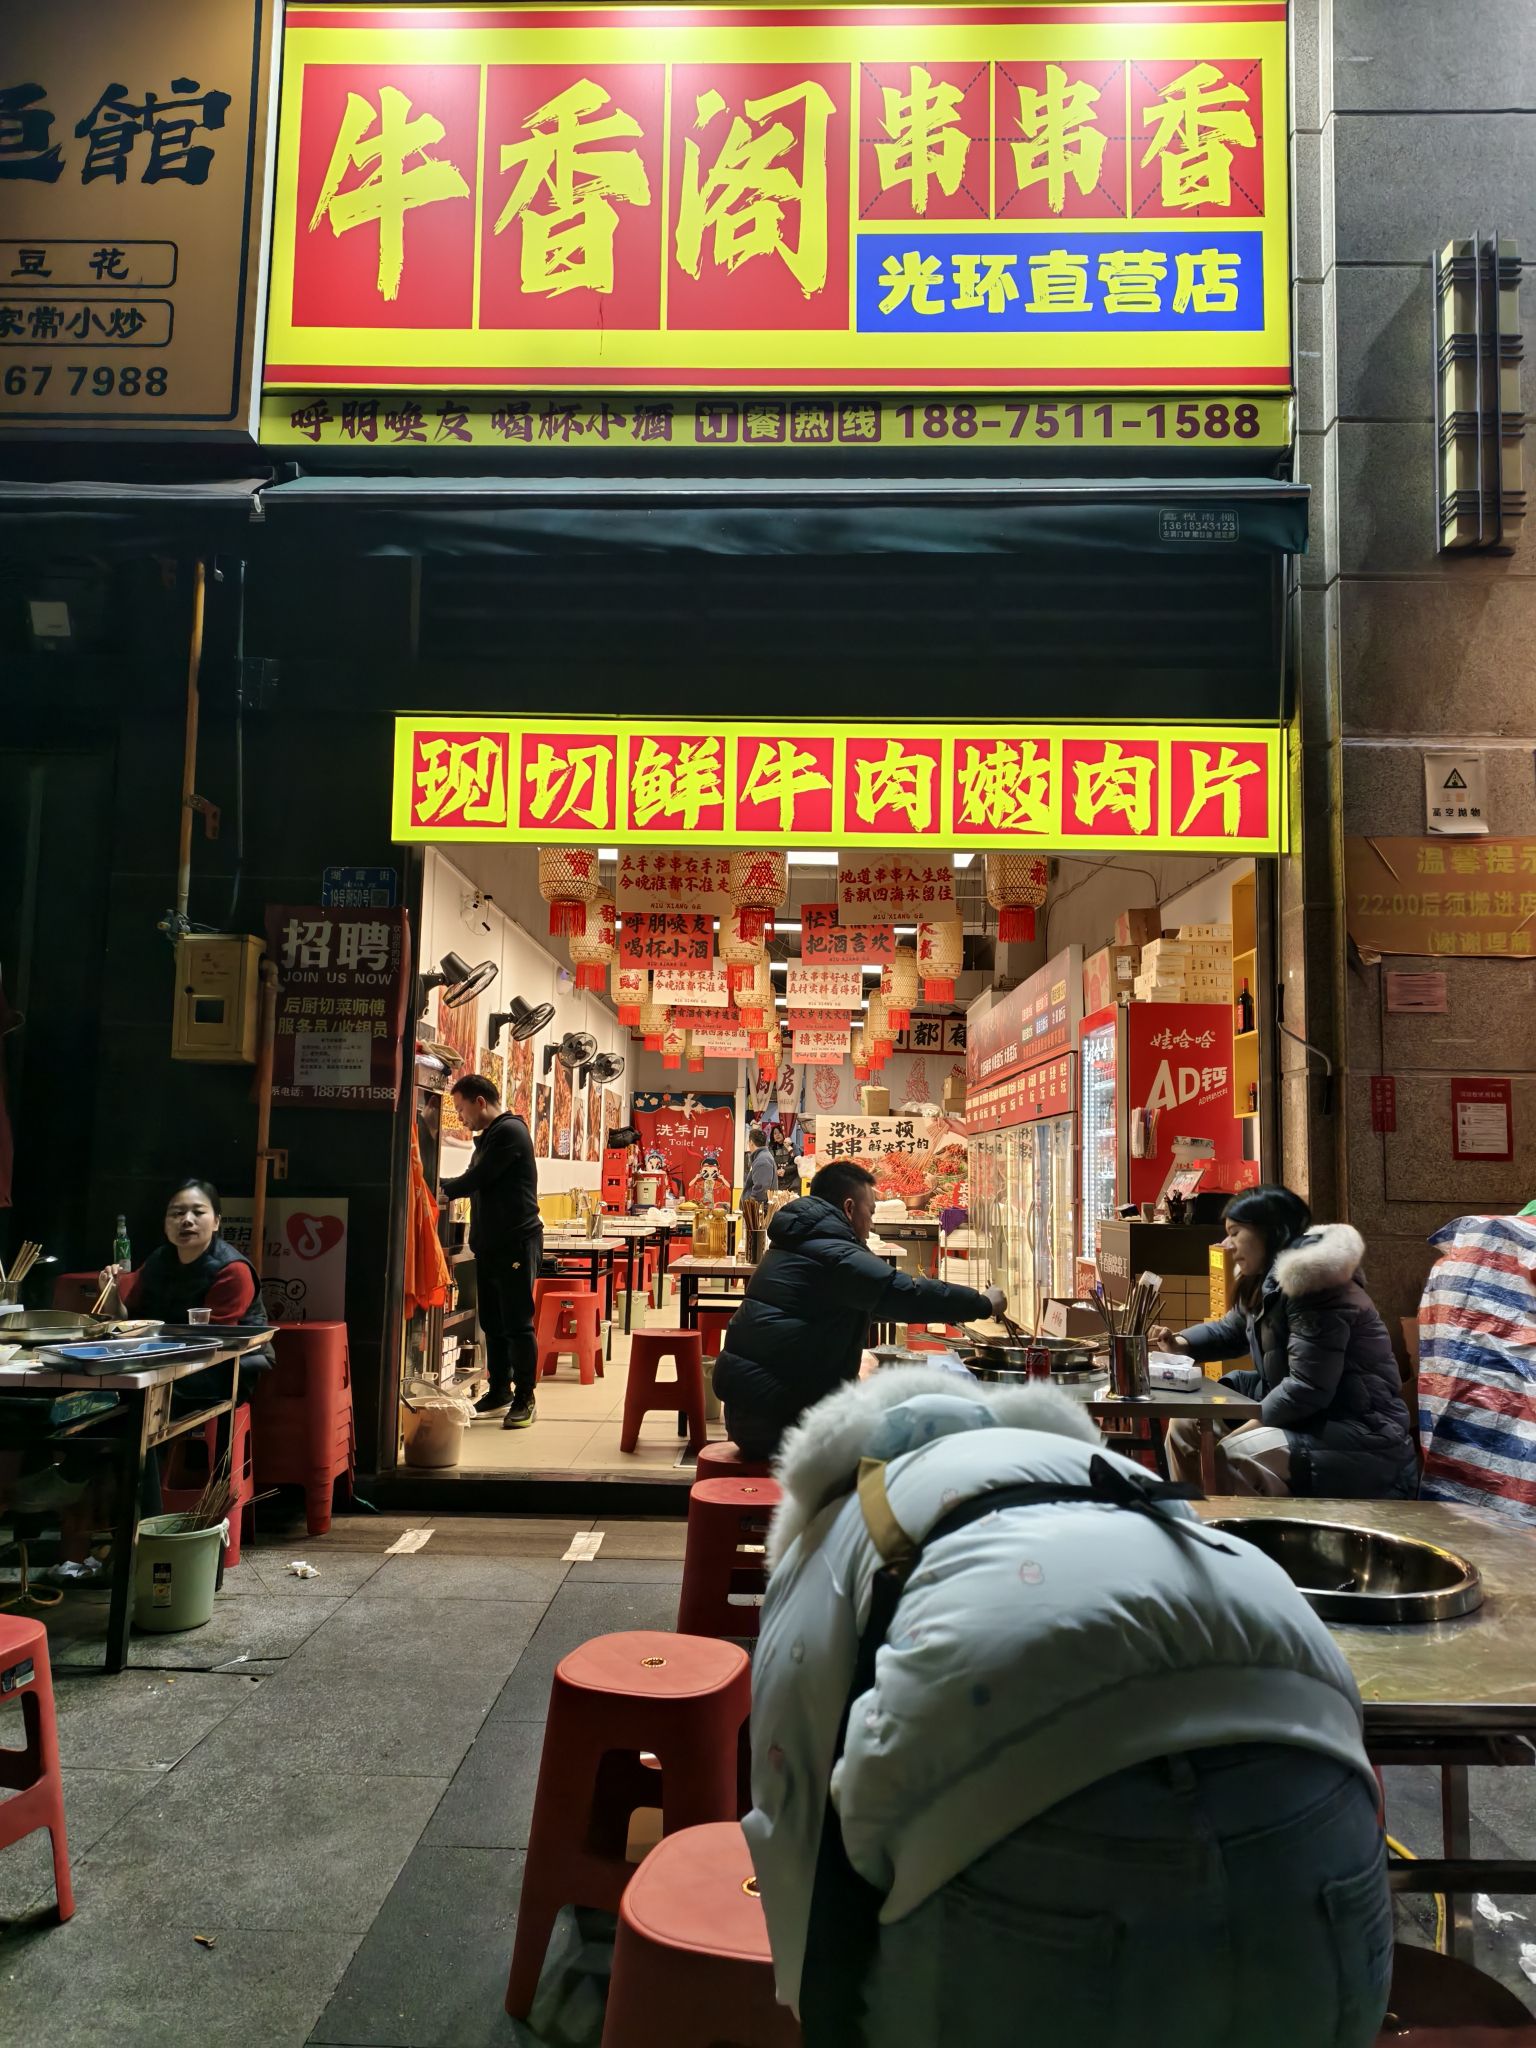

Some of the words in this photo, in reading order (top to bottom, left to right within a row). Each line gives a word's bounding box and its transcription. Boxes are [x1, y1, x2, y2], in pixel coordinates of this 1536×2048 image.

[309, 77, 837, 302] 牛香阁
[873, 61, 1258, 214] 串串香
[10, 247, 130, 281] 豆花
[877, 248, 1242, 316] 光环直营店
[0, 306, 148, 339] 家常小炒
[290, 401, 474, 444] 呼朋唤友
[490, 402, 675, 443] 喝杯小酒
[696, 402, 881, 442] 订餐热线
[894, 403, 1262, 440] 188-7511-1588
[413, 735, 1263, 835] 现切鲜牛肉嫩肉片
[620, 854, 731, 875] 左手串串右手酒
[839, 866, 954, 885] 地道串串人生路
[624, 912, 710, 935] 呼朋唤友
[281, 918, 391, 971] 招聘
[623, 937, 709, 960] 喝杯小酒
[805, 933, 893, 955] 把酒言欢
[283, 971, 319, 984] JOIN
[326, 971, 347, 985] US
[354, 972, 393, 986] NOW
[284, 996, 387, 1017] 后厨切菜师傅
[277, 1017, 389, 1039] 服务员/收银员
[896, 1021, 967, 1048] 都有
[1150, 1028, 1215, 1050] 娃哈哈
[312, 1085, 397, 1100] 18875111588
[1145, 1059, 1228, 1112] AD钙
[656, 1123, 709, 1139] 洗手间
[669, 1139, 695, 1147] Toilet
[826, 1138, 929, 1159] 串串解决不了的
